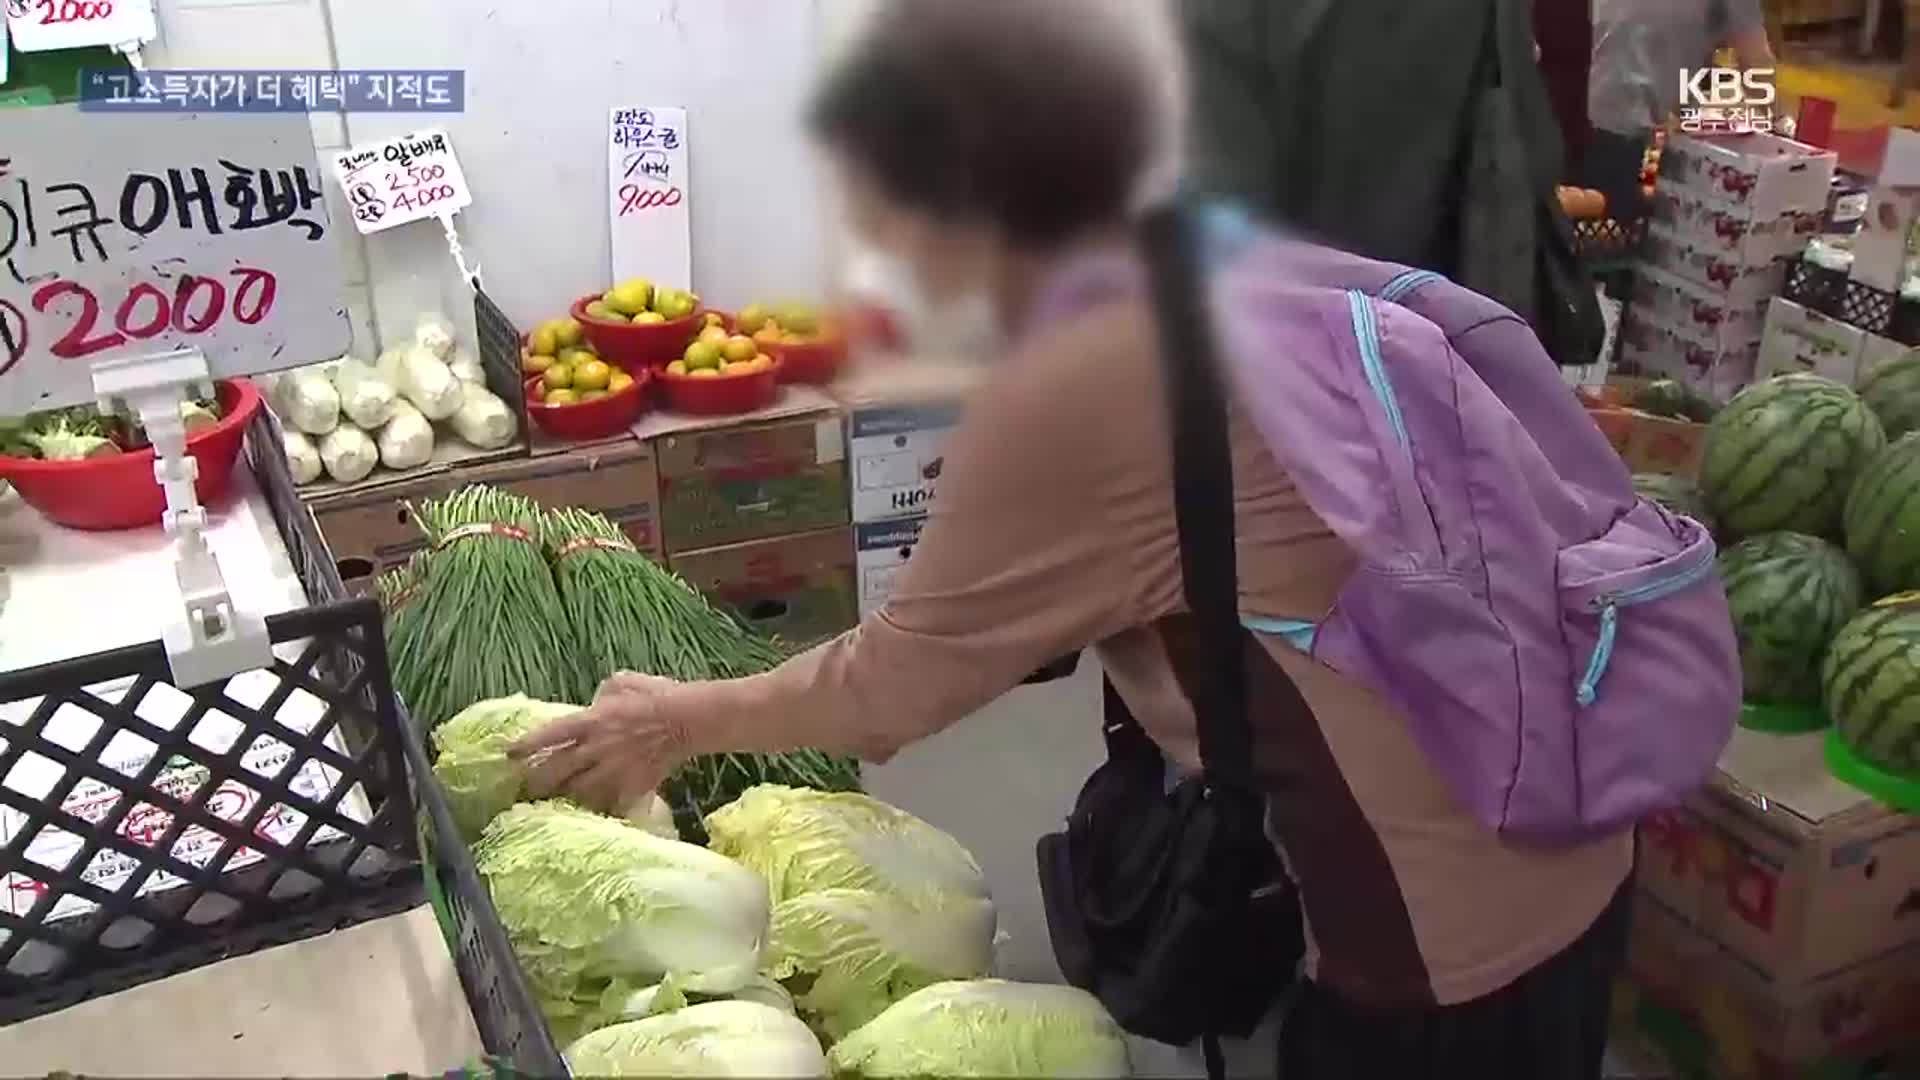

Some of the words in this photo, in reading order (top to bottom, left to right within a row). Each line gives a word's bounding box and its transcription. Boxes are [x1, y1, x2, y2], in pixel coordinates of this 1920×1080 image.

[36, 0, 113, 25] 2000
[392, 184, 455, 212] 4000
[31, 267, 277, 359] 2000
